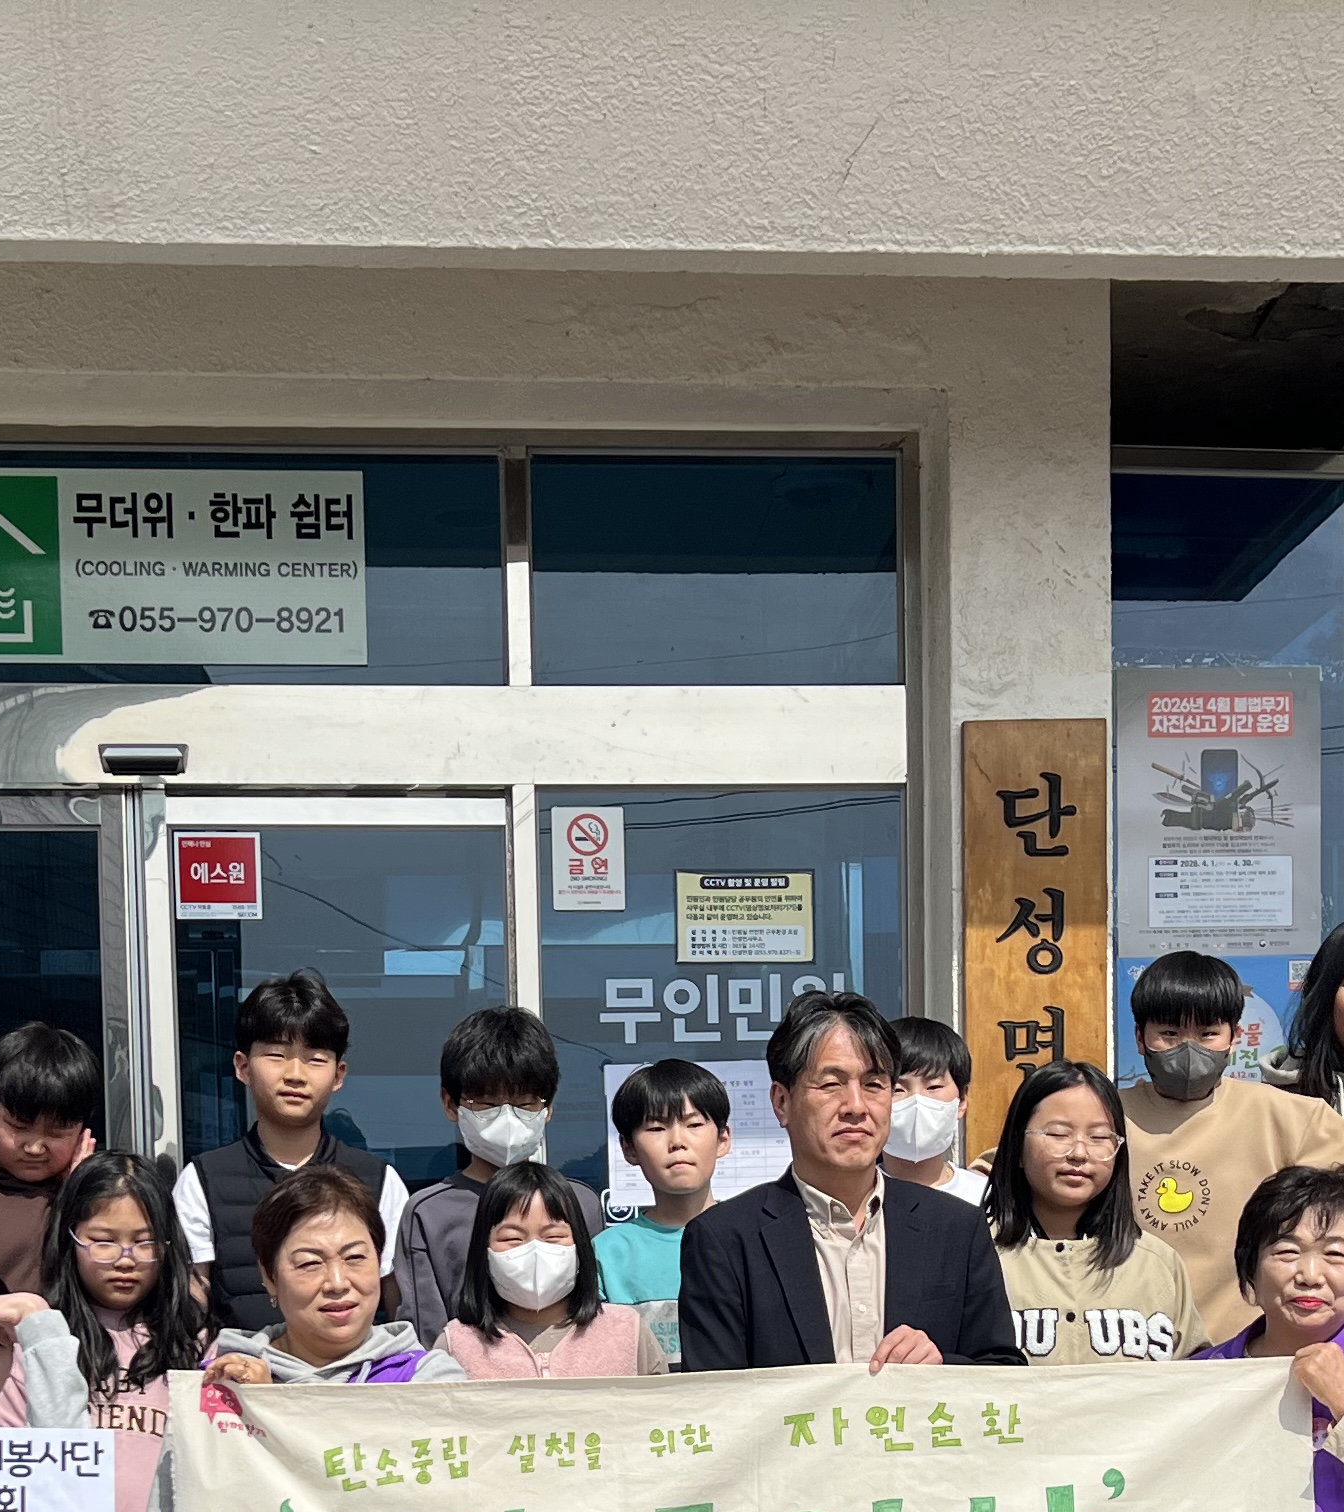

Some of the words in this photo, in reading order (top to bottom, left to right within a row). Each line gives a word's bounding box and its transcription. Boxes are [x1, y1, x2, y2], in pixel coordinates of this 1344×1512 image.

[73, 491, 174, 539] 무더위
[210, 492, 277, 539] 한파
[290, 492, 355, 541] 쉼터
[75, 559, 165, 577] (COOLING
[183, 561, 271, 578] WARMING
[277, 561, 358, 580] CENTER)
[1152, 697, 1203, 713] 2026년
[1206, 697, 1230, 713] 4월
[1234, 697, 1290, 713] 불법무기
[1152, 715, 1217, 733] 자진신고
[1221, 714, 1253, 733] 기간
[1257, 714, 1289, 733] 운영
[190, 862, 245, 884] 에스원
[1153, 1162, 1165, 1174] IT
[1169, 1160, 1201, 1176] SLOW
[1138, 1172, 1155, 1202] TAKE
[1140, 1207, 1168, 1230] AWAY
[1174, 1215, 1199, 1232] PULL
[88, 1404, 167, 1438] IEND
[323, 1435, 469, 1492] 탄소중립
[507, 1432, 602, 1473] 실천을
[649, 1423, 713, 1457] 위한
[784, 1401, 1024, 1452] 자원순환
